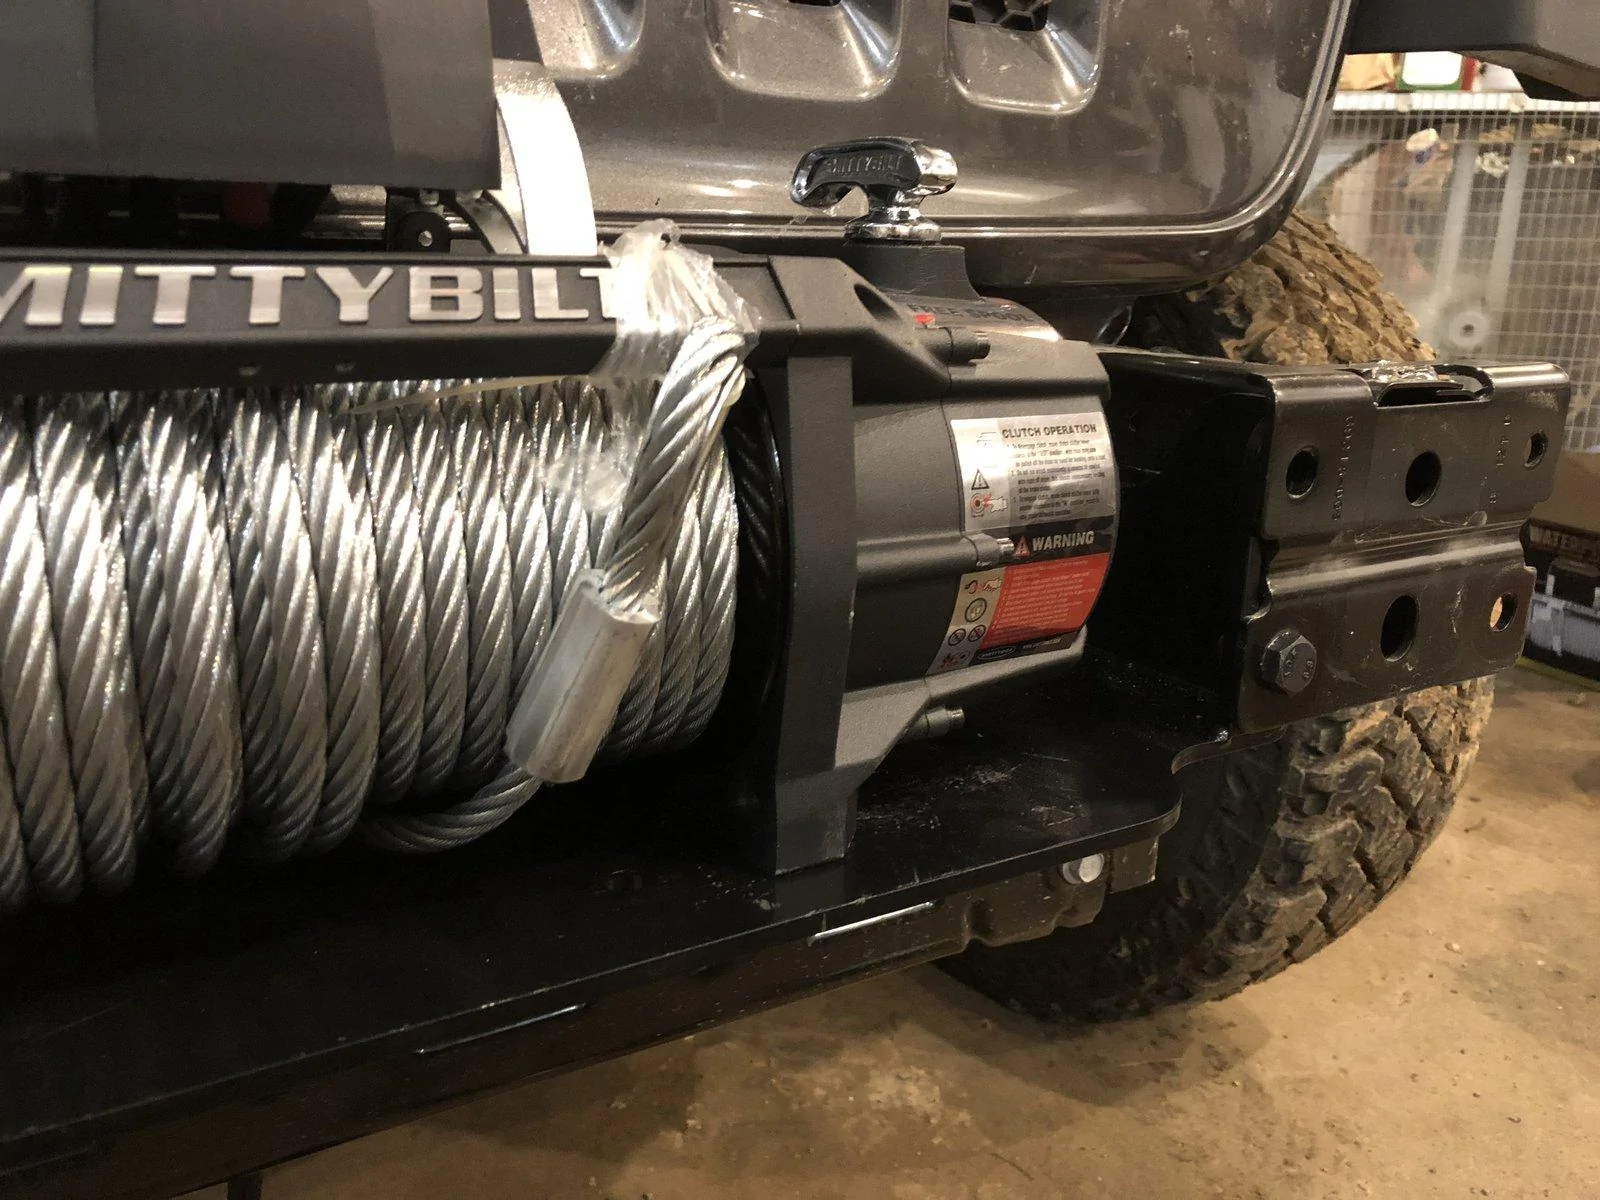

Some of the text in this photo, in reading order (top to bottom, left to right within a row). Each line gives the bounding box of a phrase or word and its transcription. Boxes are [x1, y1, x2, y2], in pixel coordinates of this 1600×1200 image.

[1001, 423, 1097, 439] CLUTCH OPERATION
[1032, 530, 1095, 551] WARNING
